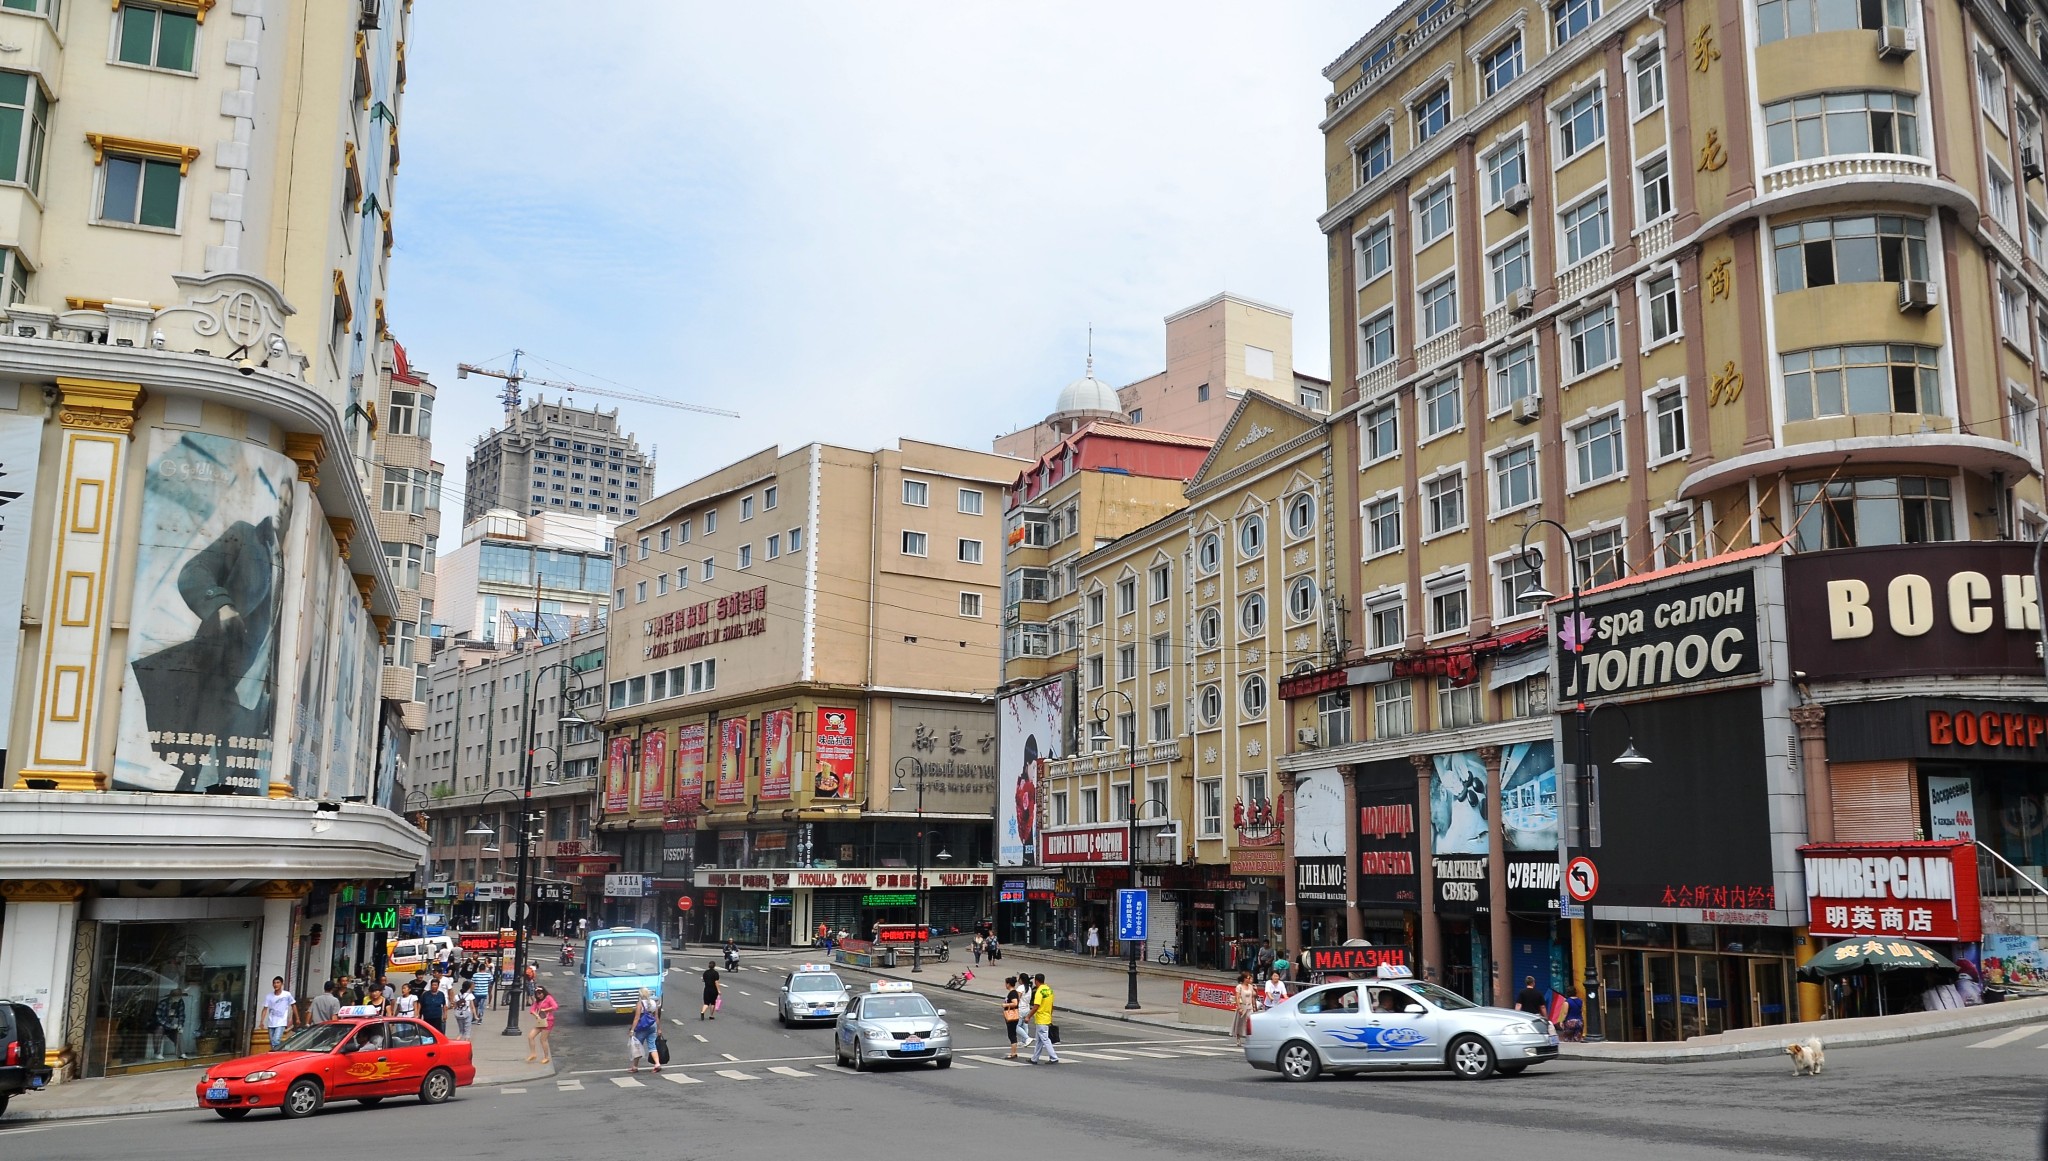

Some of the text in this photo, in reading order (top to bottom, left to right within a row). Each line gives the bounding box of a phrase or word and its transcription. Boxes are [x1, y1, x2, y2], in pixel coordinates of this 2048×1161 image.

[1597, 587, 1745, 646] spa салон
[1928, 710, 2048, 747] ВОСКР
[1361, 804, 1414, 839] МОДНИЦА
[1363, 851, 1414, 875] КОКЕТКА
[798, 873, 837, 886] ПЛОЩАДЬ
[1066, 868, 1095, 884] МЕХА
[1299, 864, 1342, 890] ДИНАМО
[1804, 856, 1952, 899] УНИВЕРСАМ
[1442, 882, 1479, 901] СВЯЗЬ
[361, 908, 396, 929] ЧАЙ
[1825, 906, 1933, 932] 明英商店
[1315, 950, 1404, 969] МАГАЗИН
